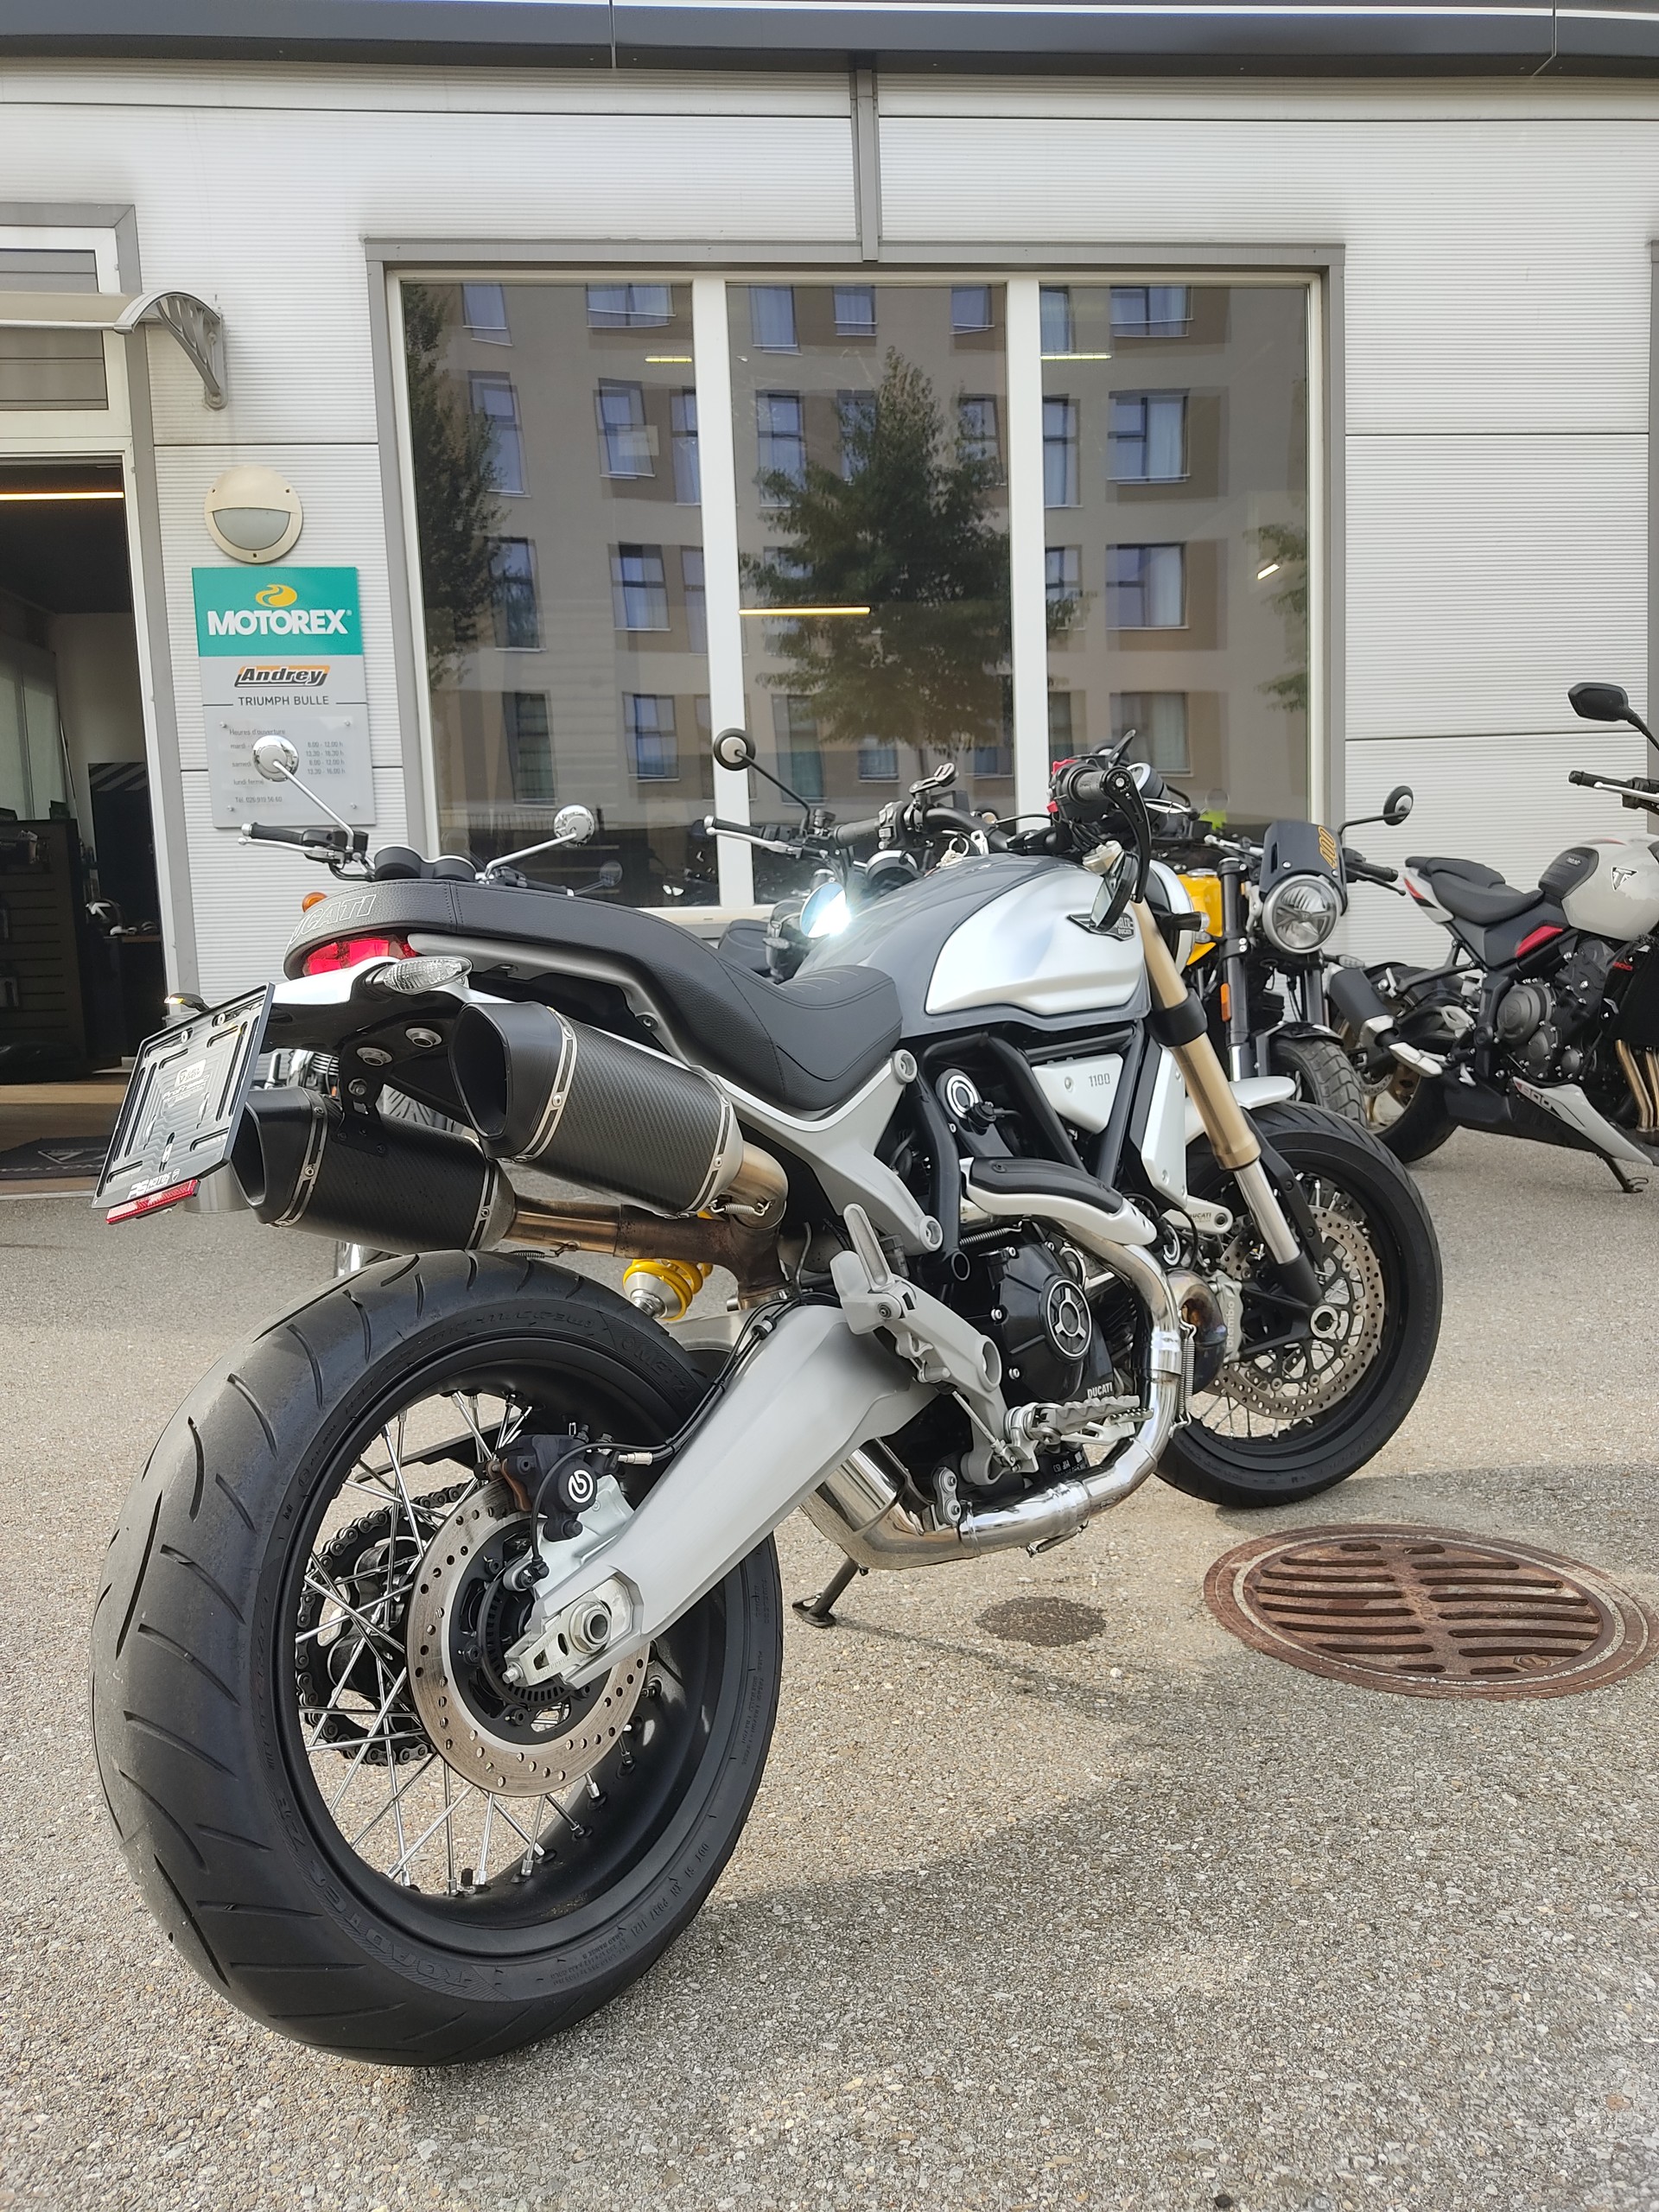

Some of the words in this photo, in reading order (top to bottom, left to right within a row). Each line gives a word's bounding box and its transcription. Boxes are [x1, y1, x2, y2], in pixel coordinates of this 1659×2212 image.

[240, 667, 323, 685] Andrey
[238, 696, 290, 706] TRIUMPH
[294, 696, 329, 705] BULLE
[1318, 825, 1338, 869] 400
[289, 893, 377, 944] UCATI
[1088, 1072, 1111, 1088] 1100
[1226, 1300, 1236, 1348] brembo
[1087, 1382, 1113, 1400] DUCATI
[695, 1841, 709, 1862] DOT
[310, 1859, 473, 1989] ROADTEC
